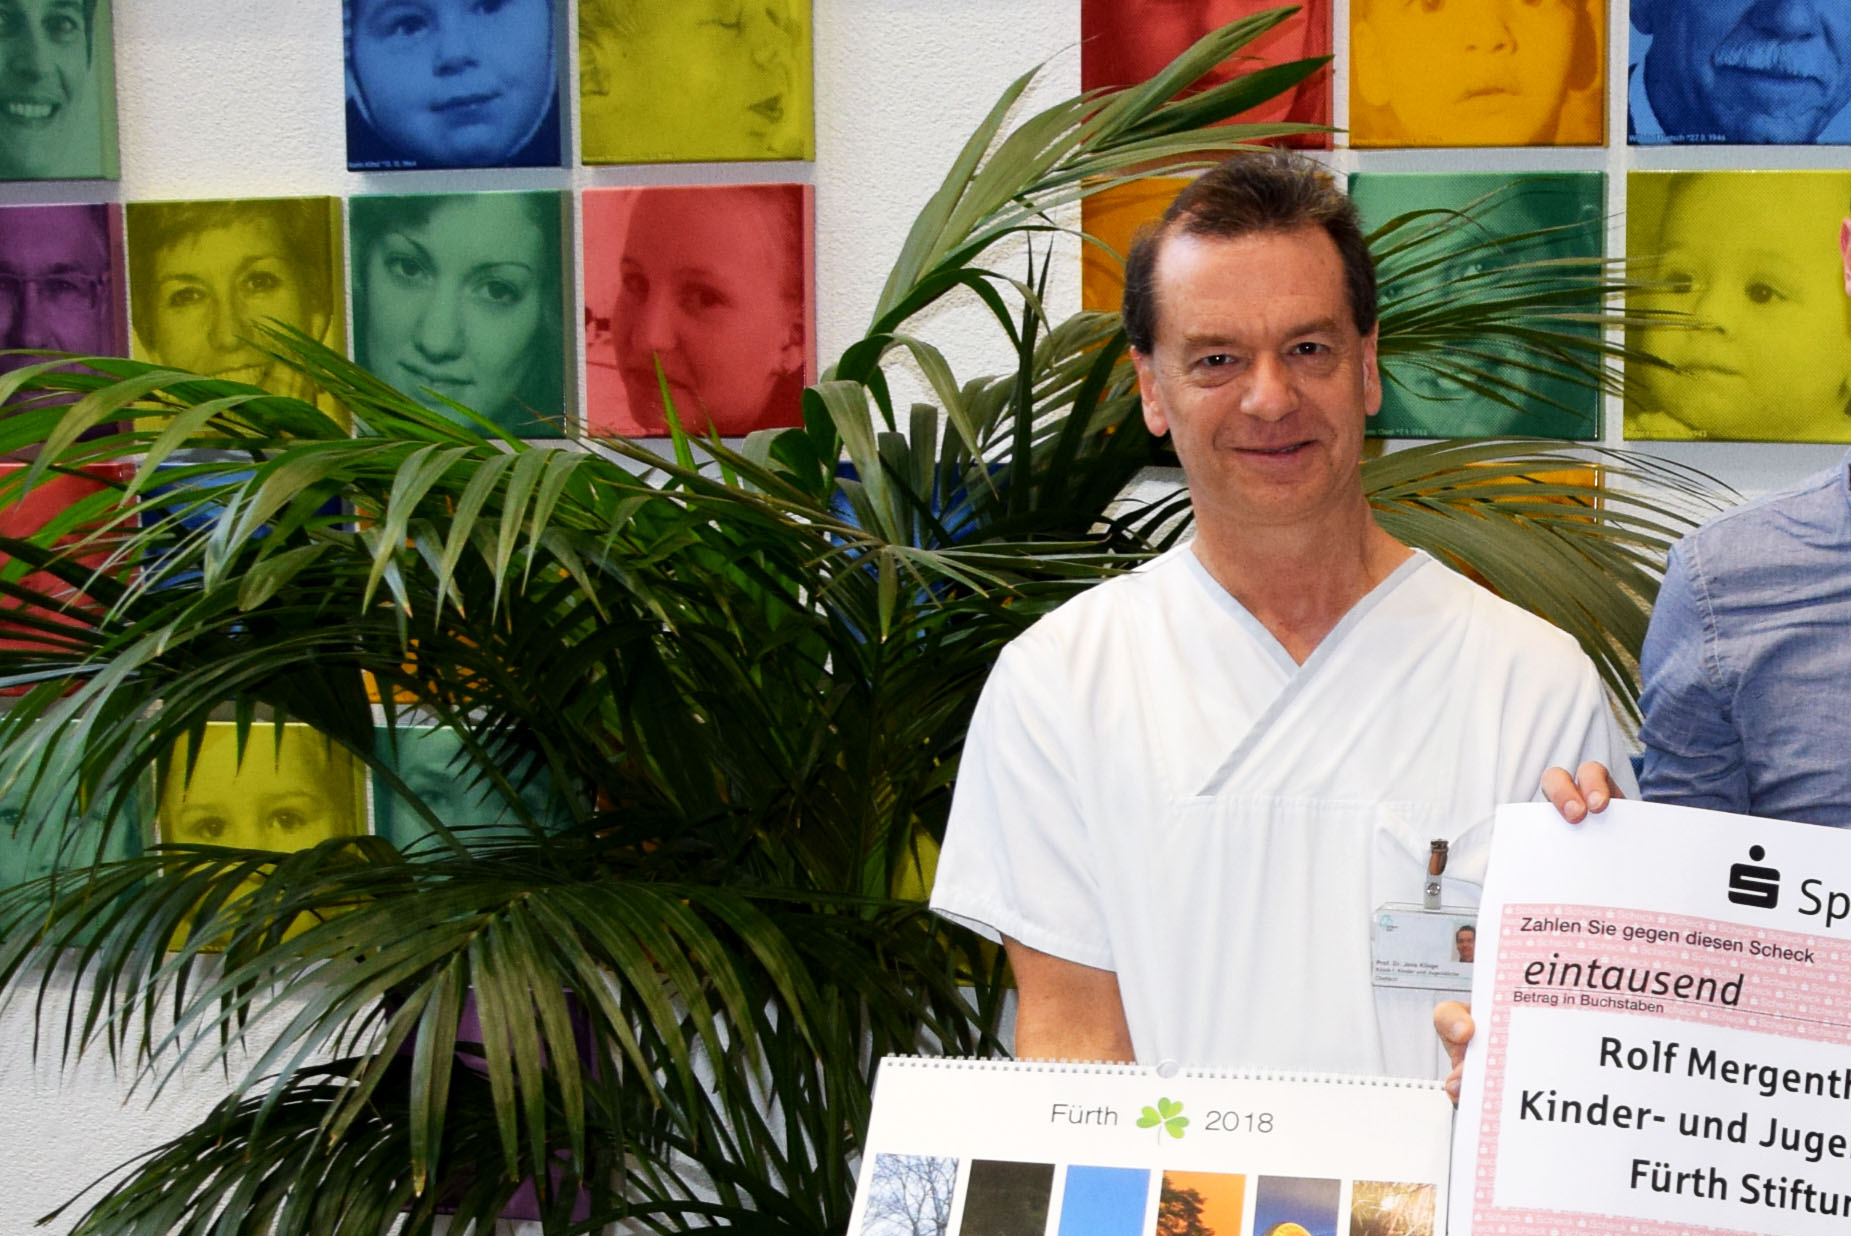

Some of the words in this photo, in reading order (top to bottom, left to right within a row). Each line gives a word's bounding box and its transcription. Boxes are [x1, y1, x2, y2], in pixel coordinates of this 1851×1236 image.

[1520, 917, 1582, 933] Zahlen
[1587, 919, 1617, 936] Sie
[1622, 926, 1680, 944] gegen
[1685, 930, 1744, 953] diesen
[1748, 940, 1815, 964] Scheck
[1524, 953, 1744, 1006] eintausend
[1513, 991, 1559, 1006] Betrag
[1563, 993, 1575, 1003] in
[1580, 995, 1664, 1012] Buchstaben
[1600, 1036, 1679, 1074] Rolf
[1050, 1103, 1118, 1126] Fürth
[1204, 1110, 1274, 1134] 2018
[1520, 1090, 1665, 1130] Kinder-
[1679, 1112, 1748, 1144] und
[1630, 1158, 1727, 1201] Fürth
